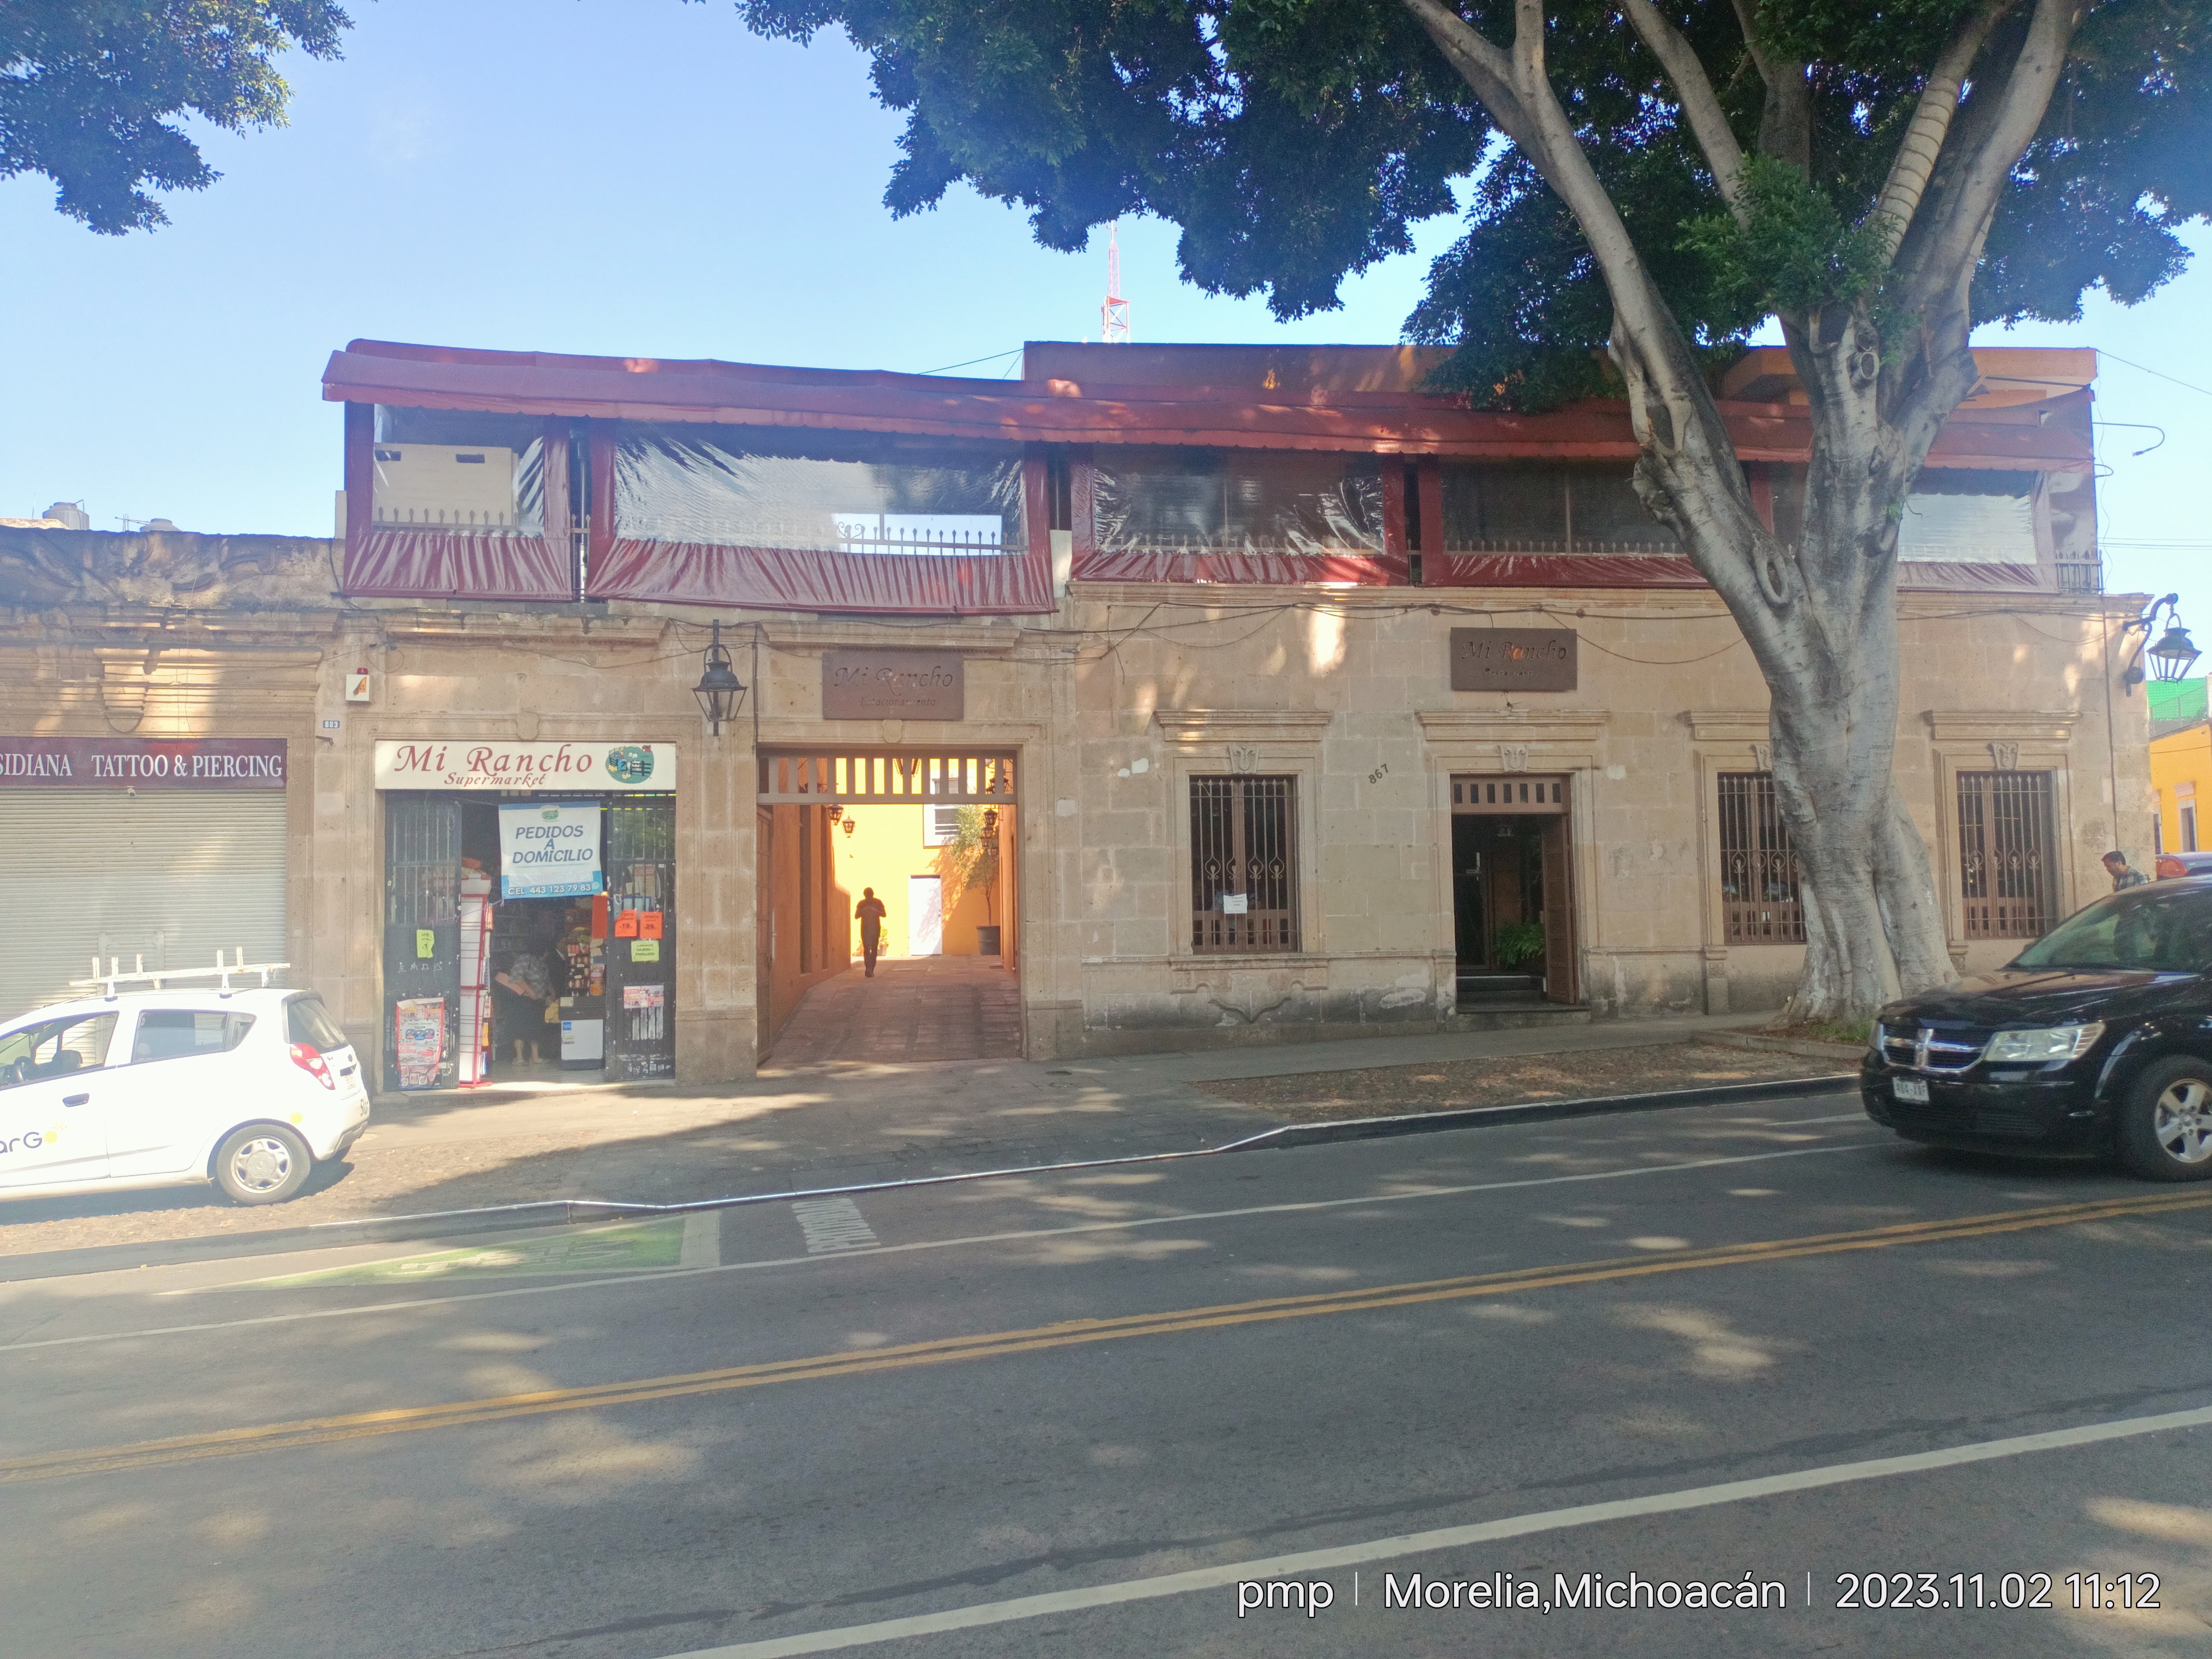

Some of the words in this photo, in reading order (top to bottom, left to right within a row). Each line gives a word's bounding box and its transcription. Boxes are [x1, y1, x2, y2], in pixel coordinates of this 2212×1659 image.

[1462, 641, 1491, 659] Mi
[1499, 640, 1567, 668] Rancho
[834, 666, 869, 687] Mi
[876, 665, 953, 696] Rancho
[91, 754, 168, 777] TATTOO
[174, 754, 188, 777] &
[192, 755, 282, 777] PIERCING
[394, 744, 448, 772] Mi
[467, 743, 593, 777] Rancho
[444, 772, 547, 788] Supermarket
[1368, 763, 1388, 784] 867
[516, 825, 584, 839] PEDIDOS
[544, 838, 555, 850] A
[512, 848, 593, 864] DOMICILIO
[508, 887, 527, 895] CEL.
[530, 886, 546, 894] 443
[549, 885, 565, 893] 123
[568, 884, 578, 893] 79
[580, 883, 591, 892] 83
